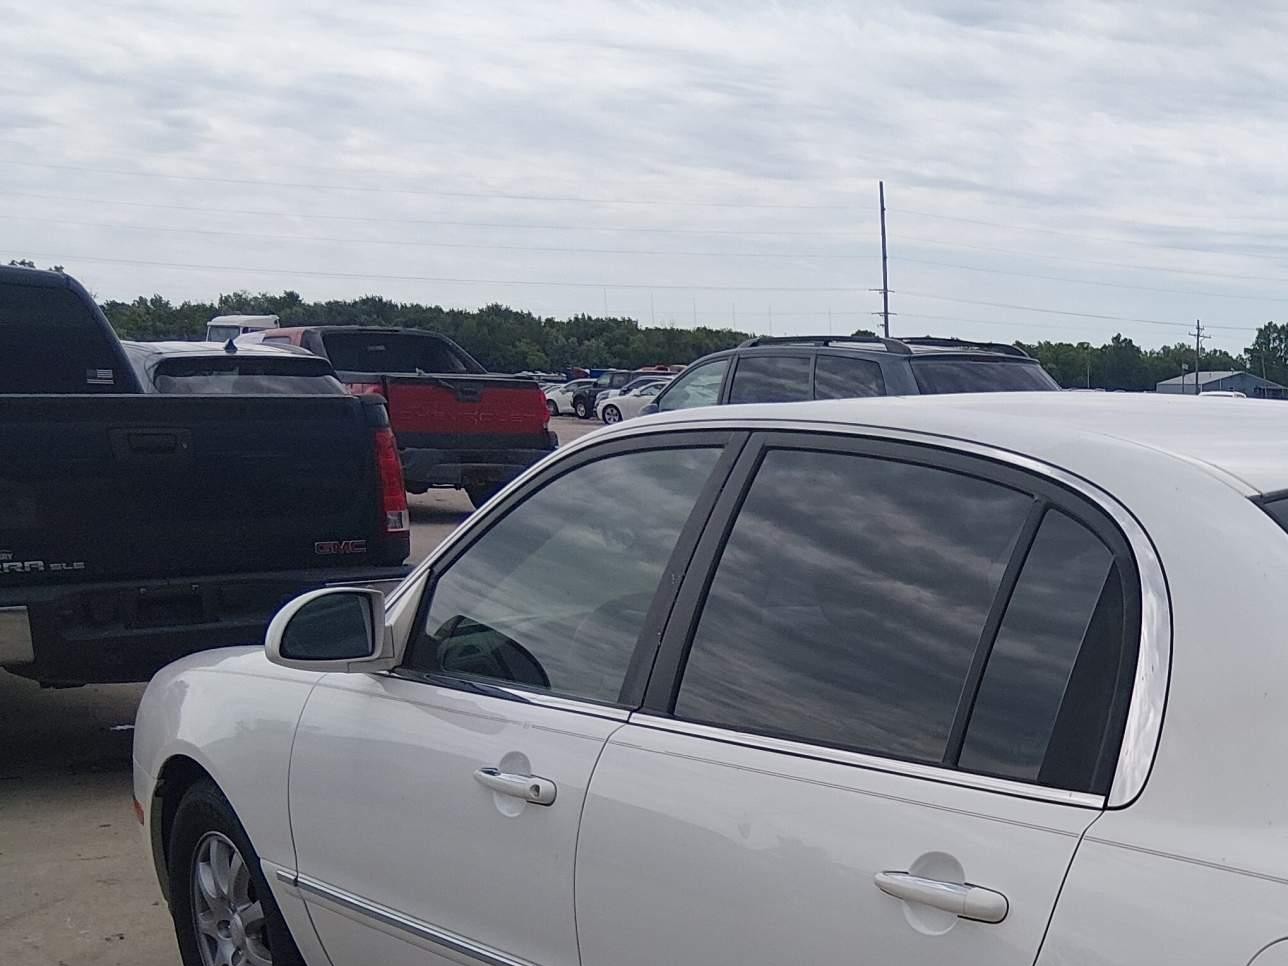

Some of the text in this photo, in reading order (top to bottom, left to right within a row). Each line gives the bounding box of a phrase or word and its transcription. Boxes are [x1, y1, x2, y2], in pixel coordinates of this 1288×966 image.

[314, 539, 367, 555] GMC
[0, 560, 86, 574] RRA SLE
